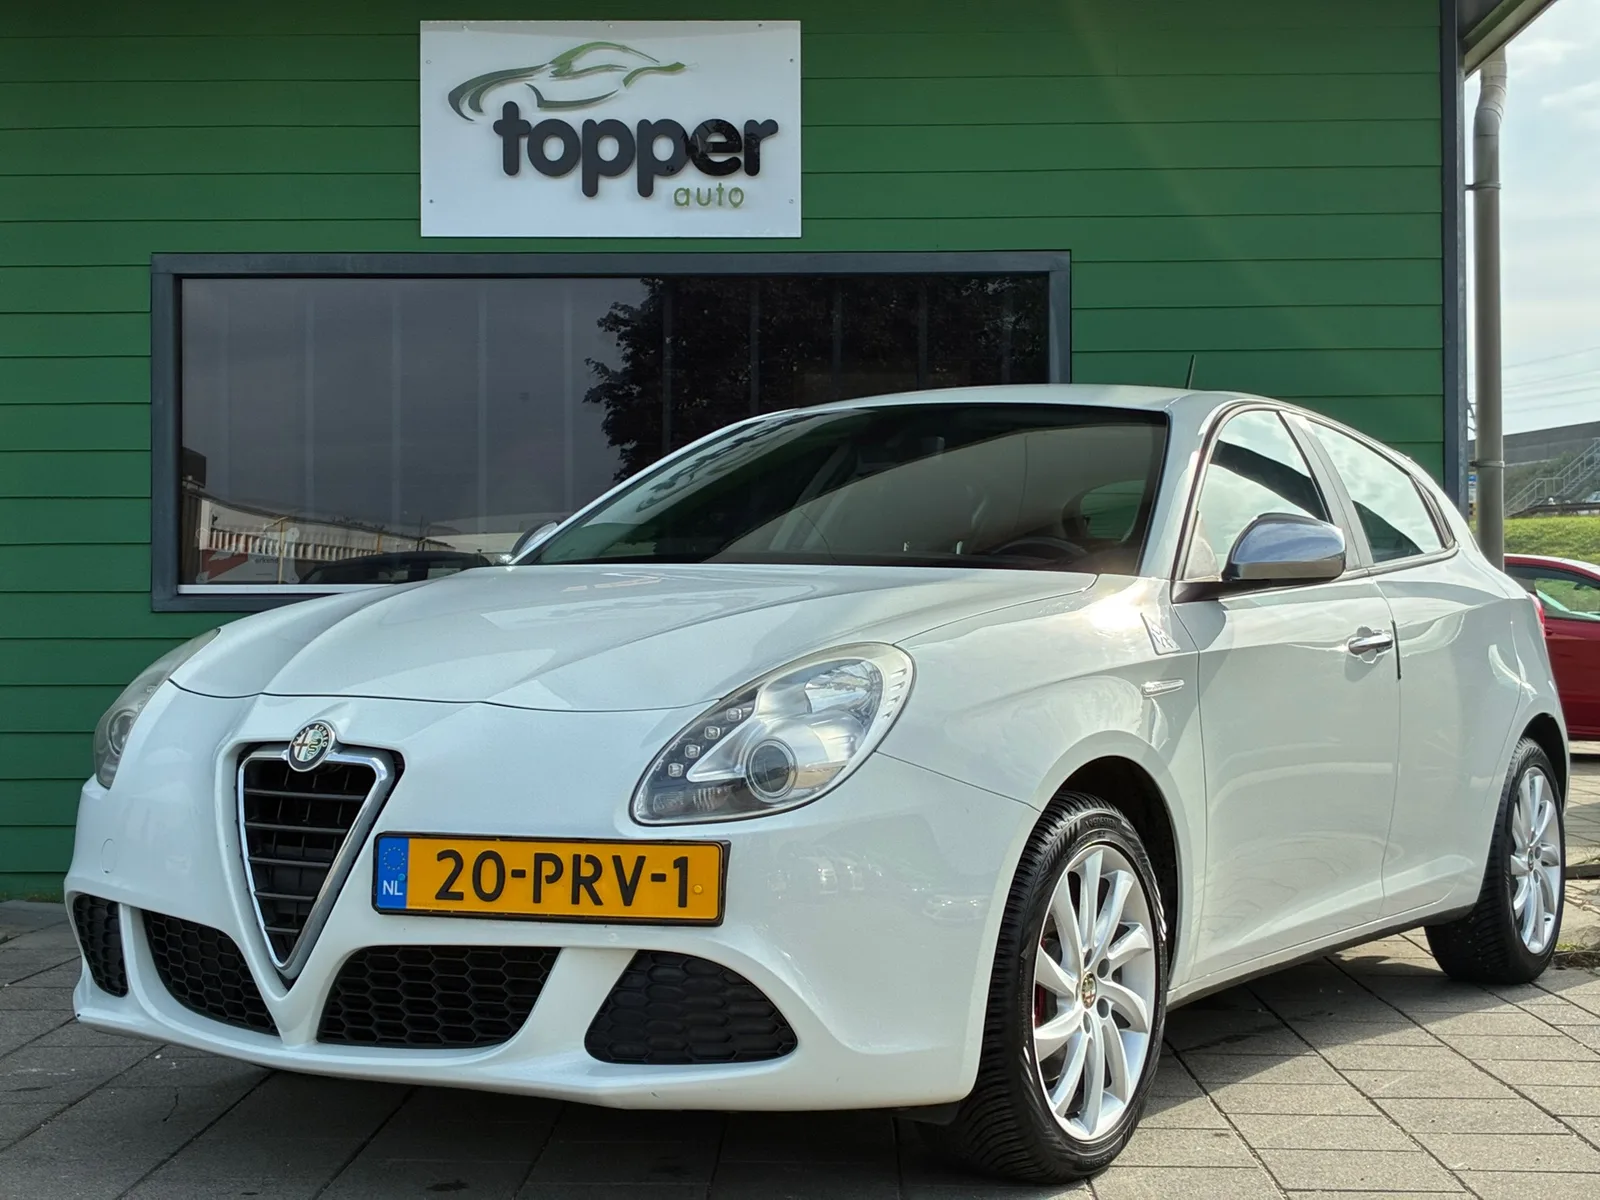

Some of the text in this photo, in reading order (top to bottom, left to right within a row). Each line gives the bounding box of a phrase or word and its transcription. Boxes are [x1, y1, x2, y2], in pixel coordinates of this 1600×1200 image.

[493, 101, 779, 198] topper
[673, 182, 745, 208] auto
[382, 879, 404, 896] NL
[434, 849, 689, 908] 20-PRV-1
